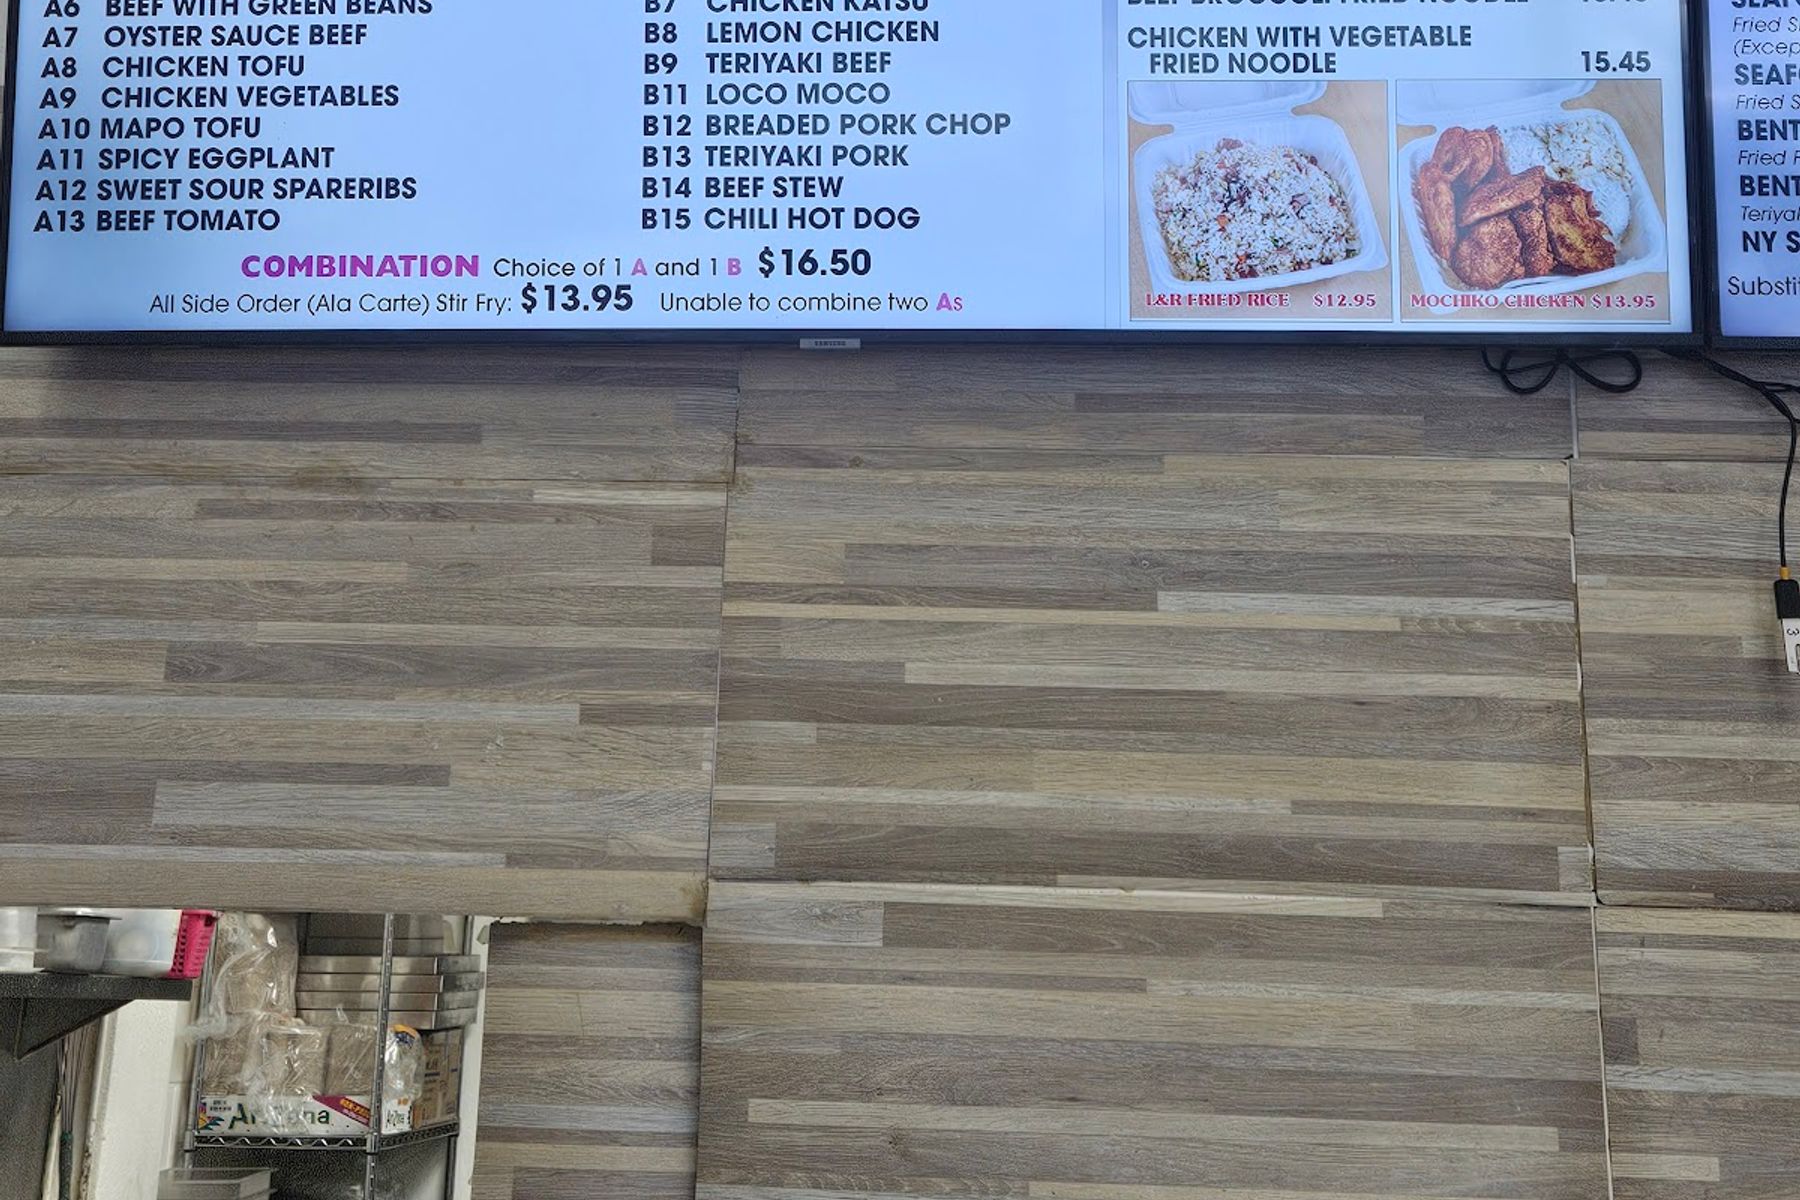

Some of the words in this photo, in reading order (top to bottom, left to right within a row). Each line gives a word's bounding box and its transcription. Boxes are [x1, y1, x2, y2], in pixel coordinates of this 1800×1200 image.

[1733, 17, 1781, 32] Fried
[1128, 27, 1247, 48] CHICKEN
[1257, 26, 1320, 47] WITH
[1329, 26, 1471, 47] VEGETABLE
[1150, 53, 1219, 74] FRIED
[1229, 53, 1336, 74] NOODLE
[1581, 51, 1650, 72] 15.45
[644, 84, 686, 105] B11
[707, 83, 787, 104] LOCO
[797, 83, 890, 104] MOCO
[1736, 94, 1784, 110] Fried
[644, 114, 691, 136] B12
[707, 114, 829, 136] BREADED
[841, 114, 917, 135] PORK
[926, 113, 1010, 135] CHOP
[37, 149, 82, 170] A11
[99, 148, 179, 170] SPICY
[189, 147, 334, 169] EGGPLANT
[1739, 150, 1786, 165] Fried
[35, 179, 86, 200] A12
[97, 179, 182, 200] SWEET
[189, 179, 264, 200] SOUR
[273, 177, 416, 199] SPARERIBS
[33, 210, 85, 232] A13
[97, 210, 155, 231] BEEF
[164, 209, 280, 231] TOMATO
[1743, 231, 1777, 252] NY
[242, 255, 479, 278] COMBINATION
[494, 258, 575, 277] Choice
[584, 258, 605, 276] of
[615, 258, 620, 276] 1
[631, 258, 647, 276] A
[656, 258, 699, 276] and
[711, 258, 716, 275] 1
[728, 258, 741, 275] B
[759, 246, 871, 278] $16.50
[150, 295, 173, 313] All
[182, 294, 229, 313] Side
[237, 294, 301, 313] Order
[308, 294, 350, 316] (Ala
[359, 294, 429, 316] Carte)
[437, 294, 467, 311] Stir
[477, 294, 511, 316] Fry:
[520, 282, 634, 313] $13.95
[662, 293, 742, 311] Unable
[749, 293, 770, 311] to
[779, 293, 881, 311] combine
[888, 293, 928, 311] two
[936, 293, 962, 311] As
[1187, 293, 1242, 307] FRIED
[1248, 293, 1289, 307] RICE
[1314, 293, 1376, 307] $12.95
[1411, 294, 1498, 308] MOCHIKO
[1504, 294, 1586, 308] CHICKEN
[1592, 294, 1656, 308] $13.95
